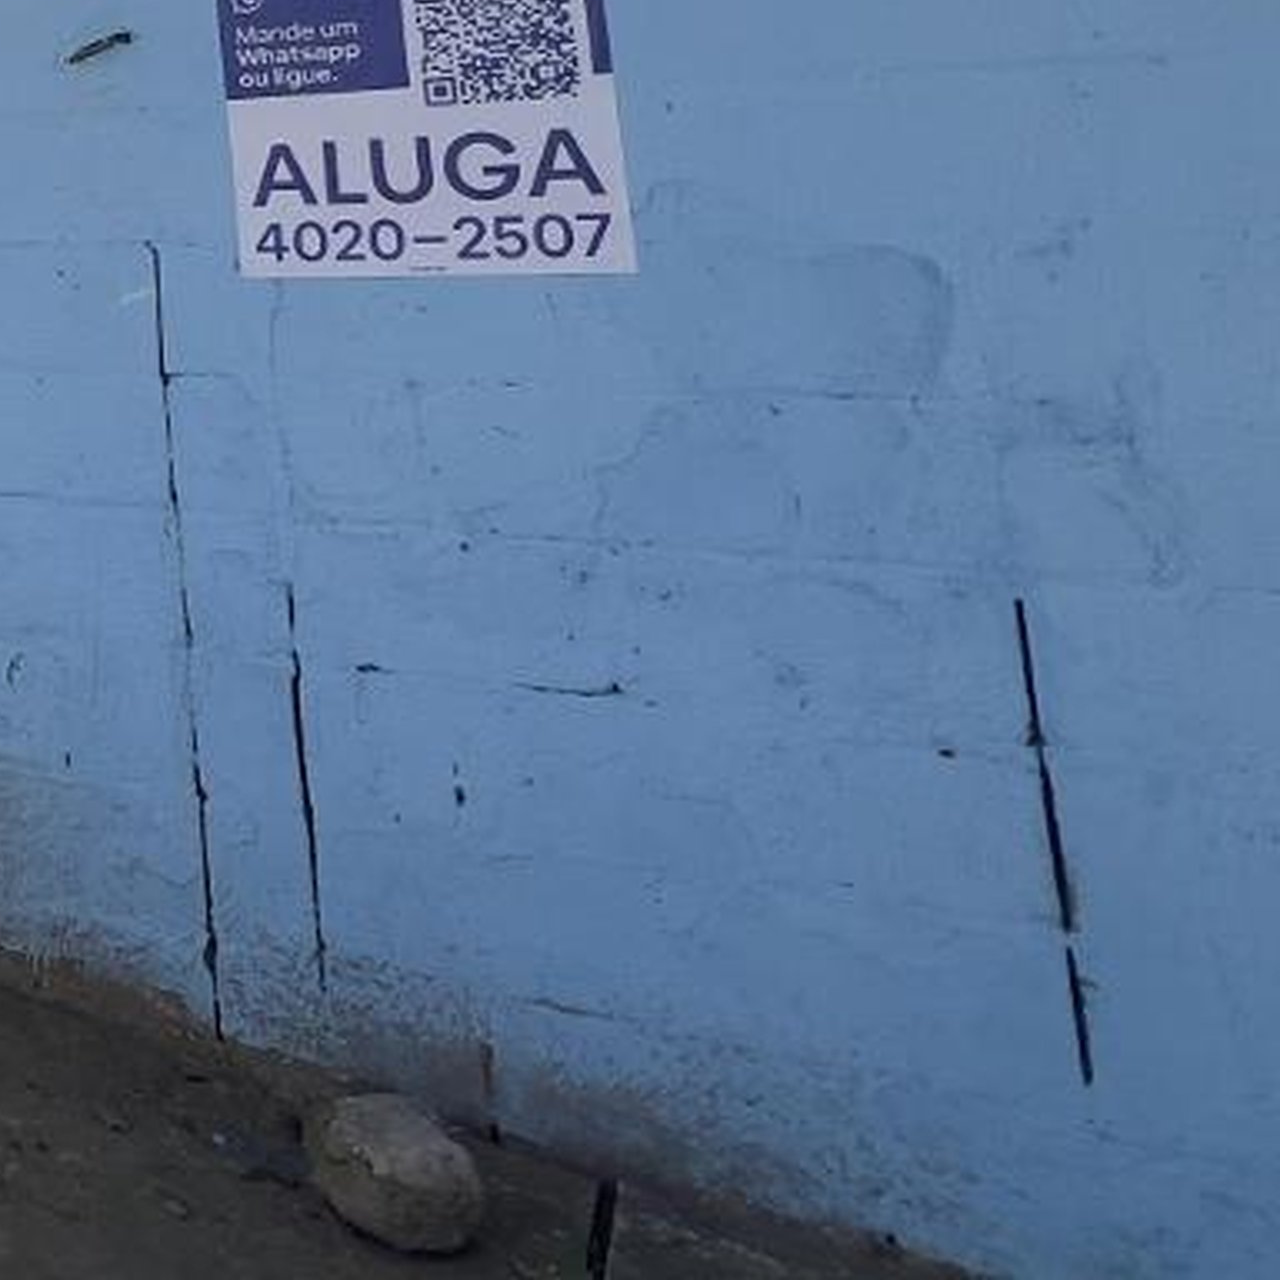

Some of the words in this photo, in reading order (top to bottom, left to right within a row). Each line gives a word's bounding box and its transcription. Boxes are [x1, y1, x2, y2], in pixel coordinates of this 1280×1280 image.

[236, 22, 314, 43] Mande
[320, 21, 358, 38] um
[239, 72, 268, 88] ou
[272, 66, 338, 90] ligue.
[252, 128, 606, 207] ALUGA
[255, 213, 612, 262] 4020-2507
